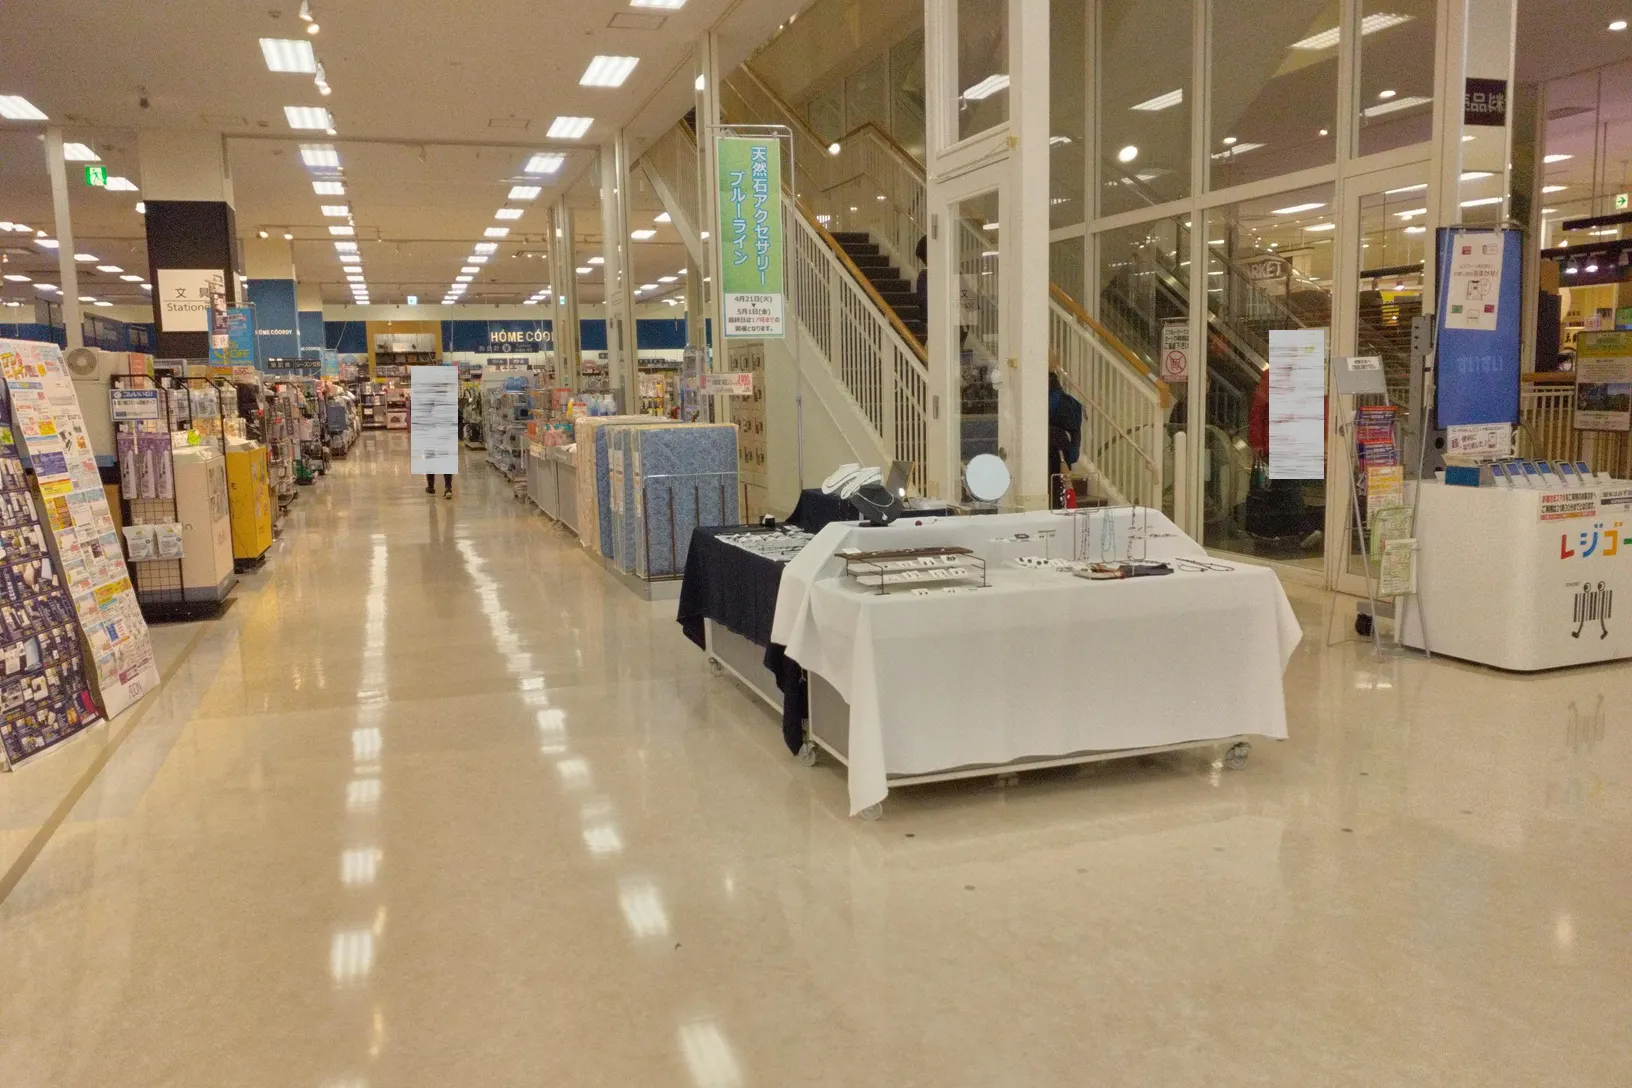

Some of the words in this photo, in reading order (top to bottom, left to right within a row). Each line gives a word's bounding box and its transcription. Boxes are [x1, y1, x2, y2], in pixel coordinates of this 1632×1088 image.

[730, 171, 749, 265] ブルーライン
[752, 146, 770, 287] 天然石アクセサリー
[734, 296, 773, 304] 4月21日(火)
